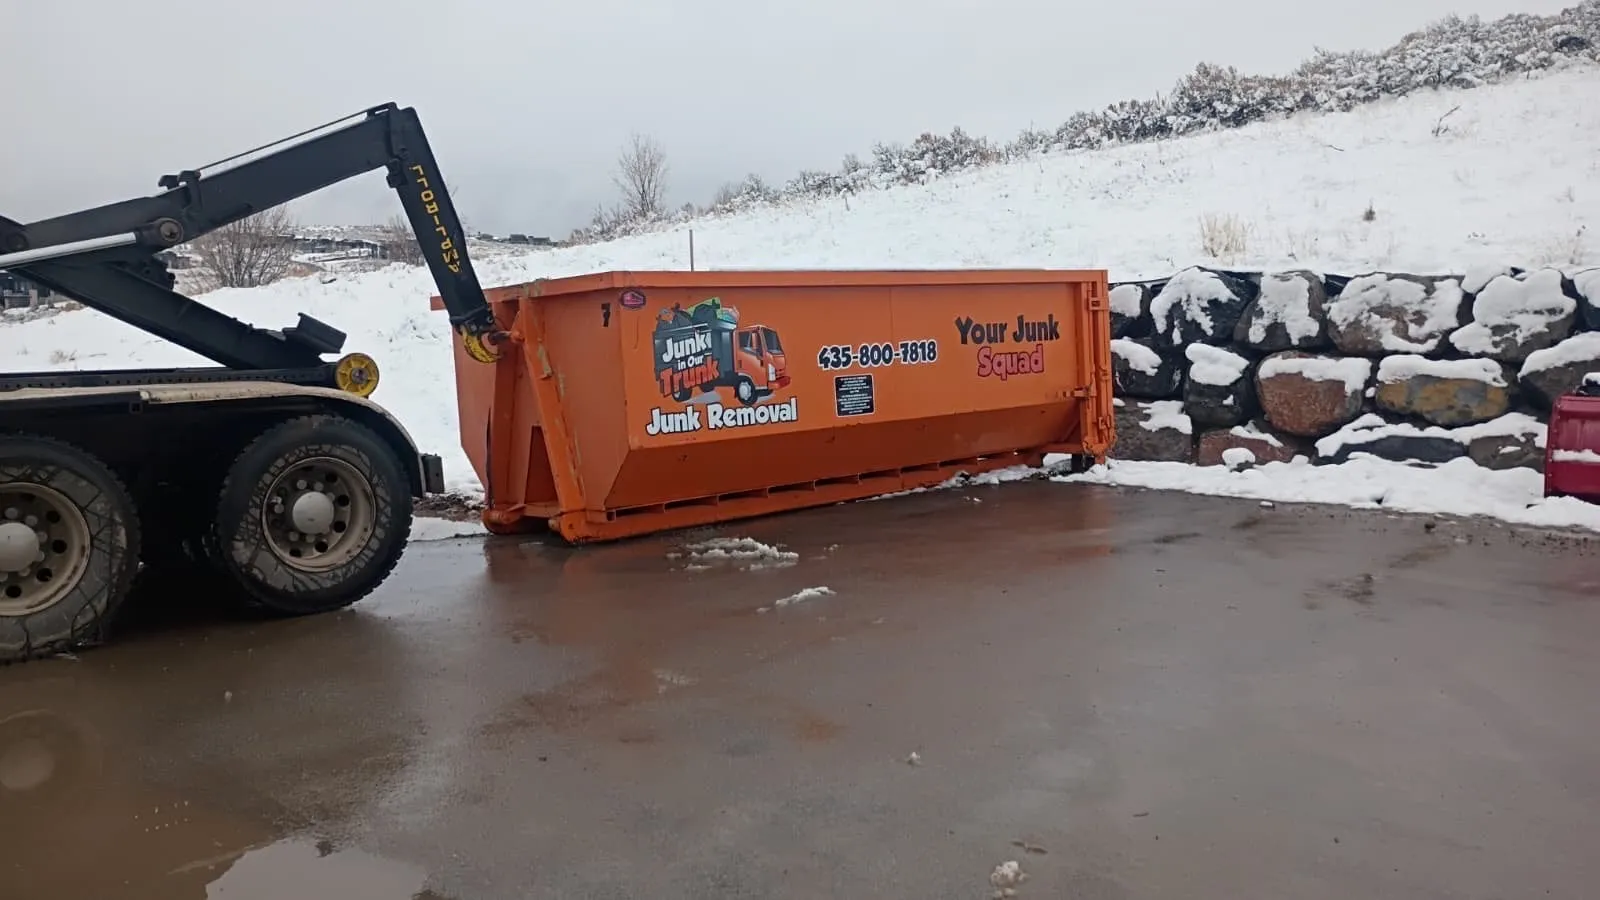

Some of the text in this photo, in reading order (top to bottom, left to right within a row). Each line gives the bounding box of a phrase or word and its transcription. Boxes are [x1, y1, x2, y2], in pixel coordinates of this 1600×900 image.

[601, 302, 612, 327] 7
[955, 314, 1061, 345] Your Junk
[662, 331, 712, 363] Junk
[677, 354, 704, 369] in Our
[818, 340, 937, 369] 435-800-7818
[977, 344, 1045, 381] Squad
[660, 358, 719, 397] Trunk
[646, 397, 798, 435] Junk Removal
